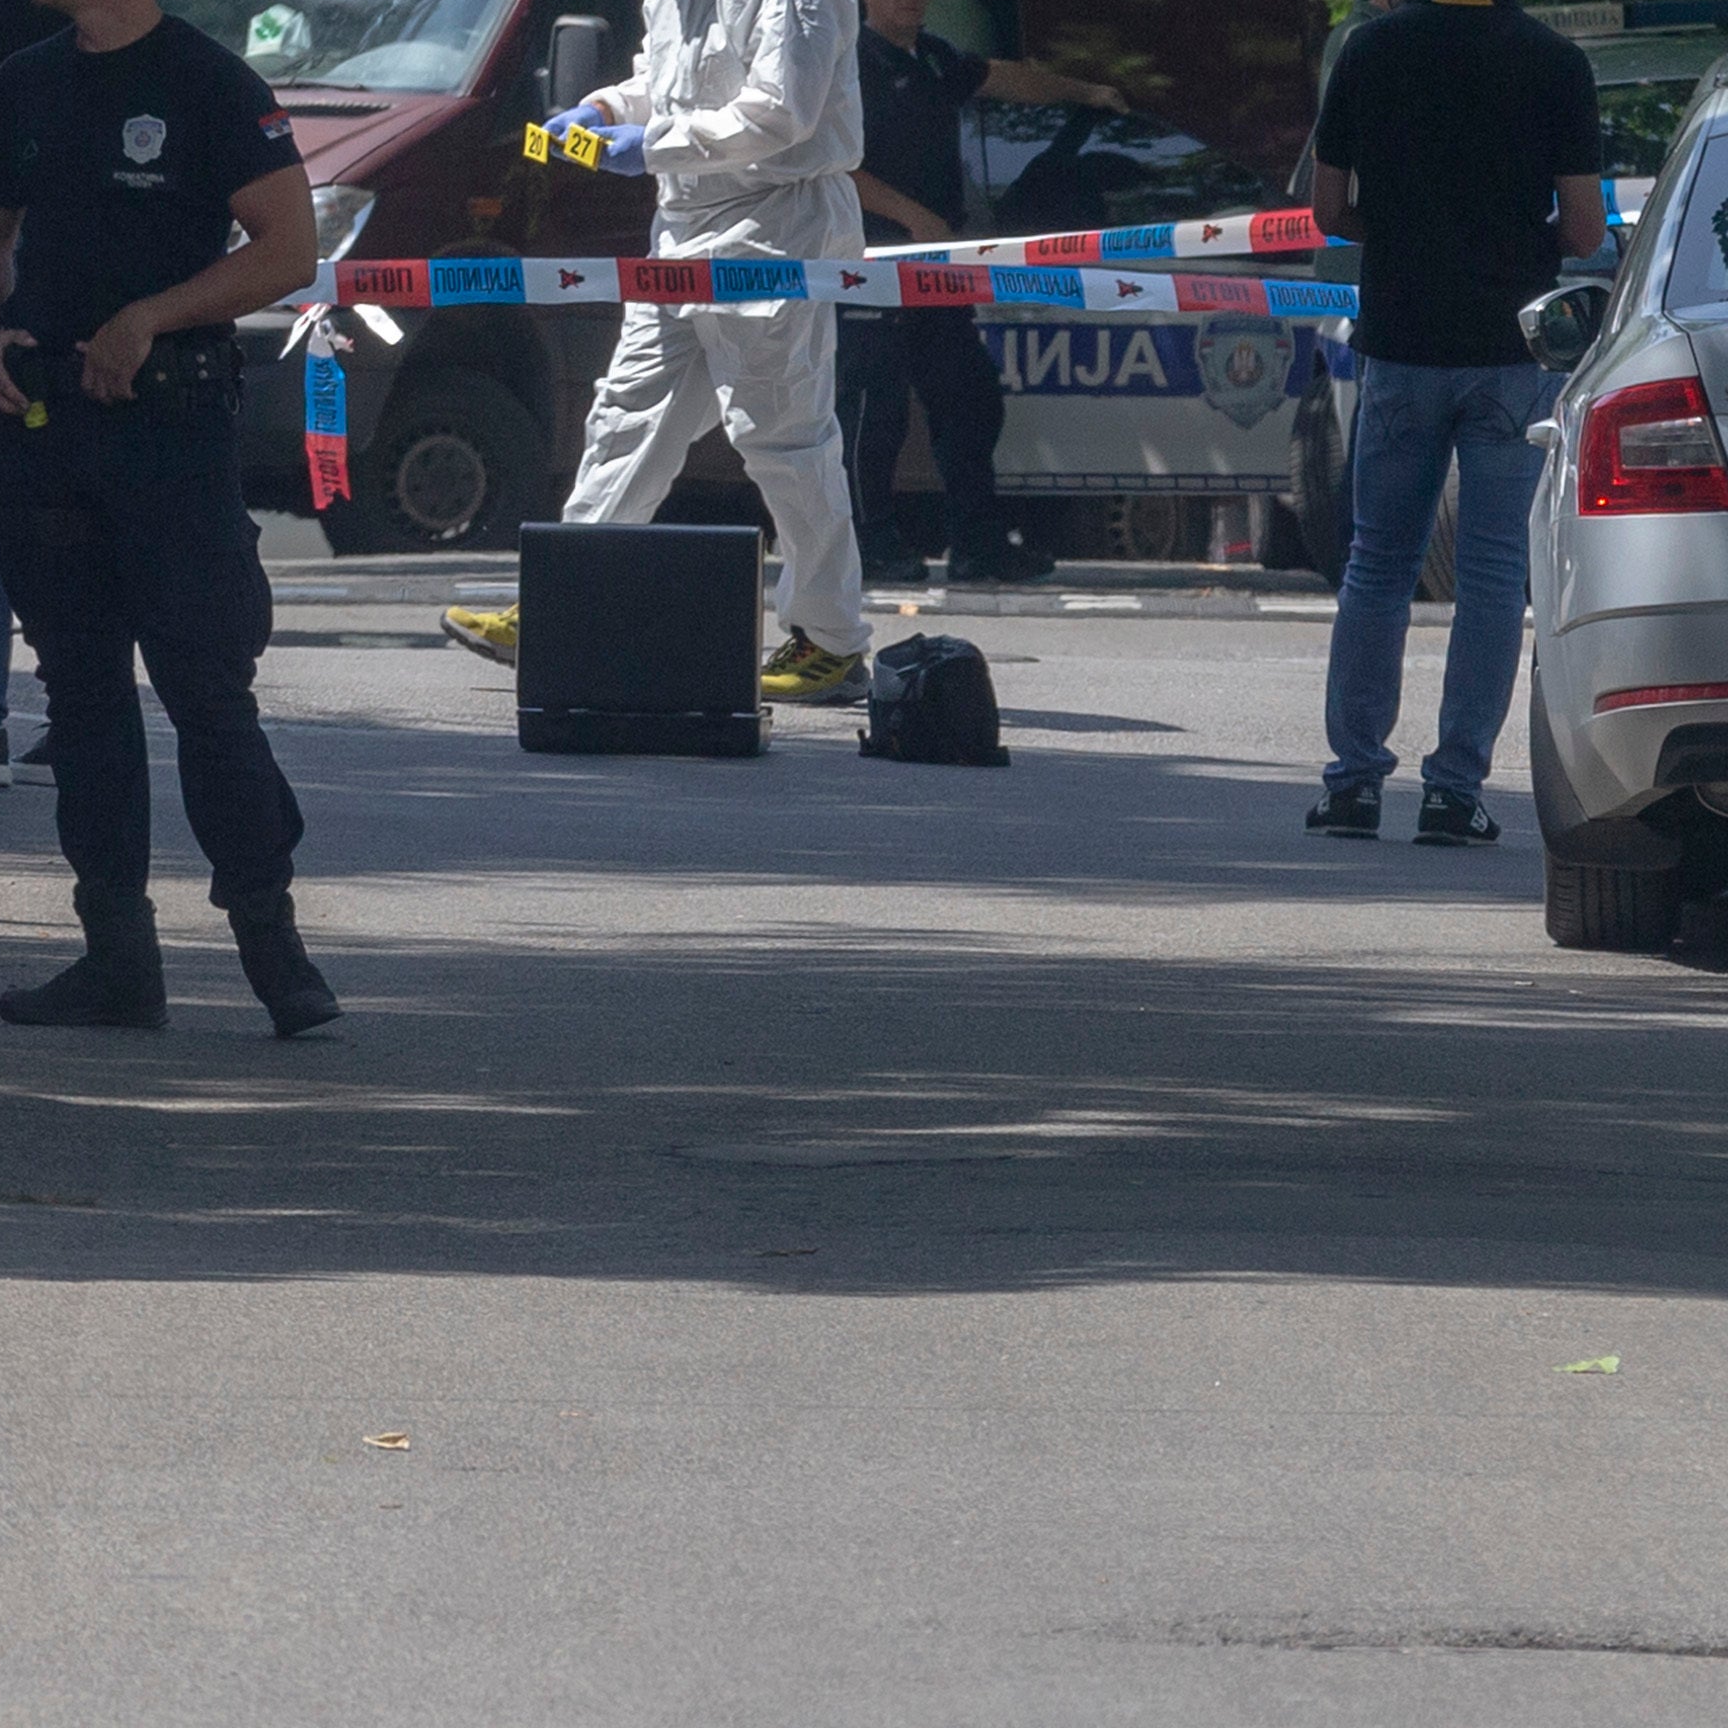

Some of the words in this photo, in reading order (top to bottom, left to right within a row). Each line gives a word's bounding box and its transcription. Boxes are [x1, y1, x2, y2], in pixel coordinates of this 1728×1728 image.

[528, 131, 544, 157] 20
[569, 131, 592, 158] 27
[1262, 215, 1311, 242] СТОП
[355, 267, 413, 293] СТОП
[434, 267, 521, 294] ПОЛИЦИЈА
[636, 266, 695, 292] СТОП
[716, 266, 803, 292] ПОЛИЦИЈА
[917, 269, 975, 294] СТОП
[995, 272, 1082, 298] ПОЛИЦИЈА
[1191, 281, 1249, 303] СТОП
[1272, 285, 1354, 309] ПОЛИЦИЈА
[979, 328, 1169, 391] ЦИЈА
